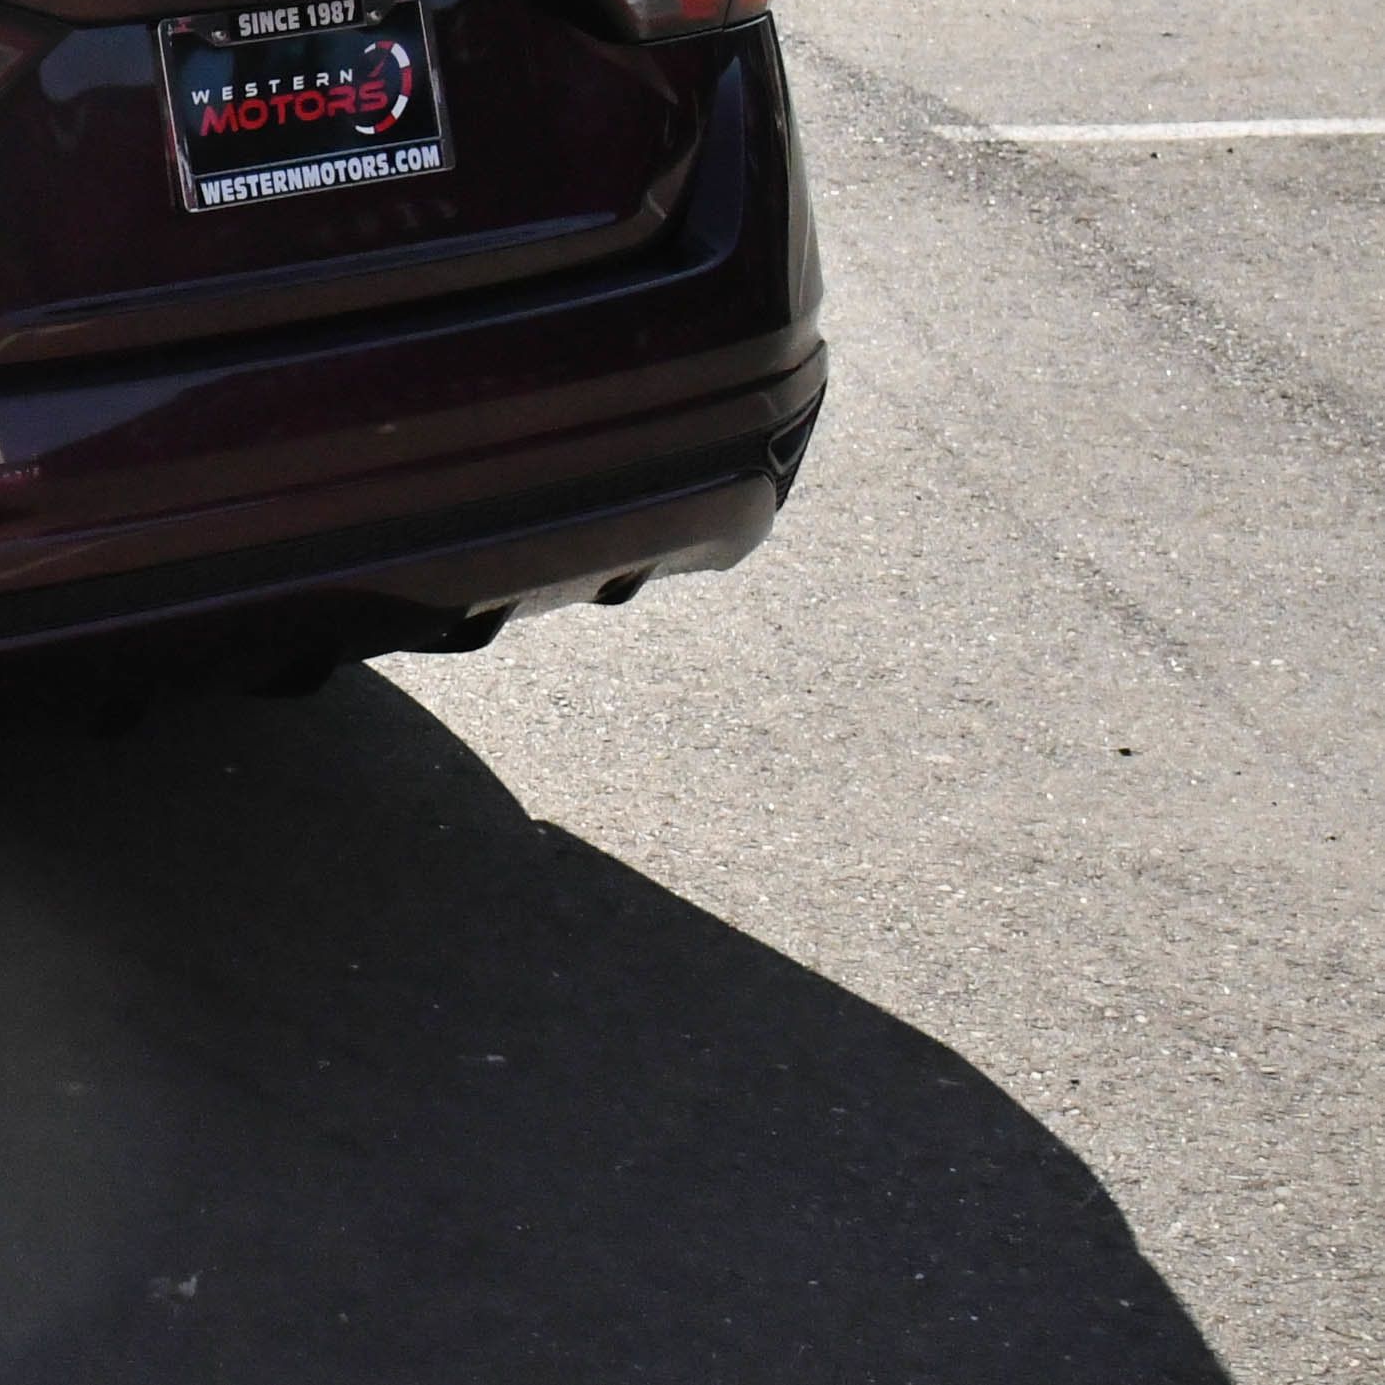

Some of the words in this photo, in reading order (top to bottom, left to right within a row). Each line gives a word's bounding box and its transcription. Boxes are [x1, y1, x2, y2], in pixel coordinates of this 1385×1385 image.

[238, 6, 300, 37] SINCE
[307, 0, 356, 27] 1987
[191, 68, 354, 105] WESTERN
[199, 80, 388, 137] MOTORS
[200, 144, 441, 206] WESTERNMOTORS.COM
